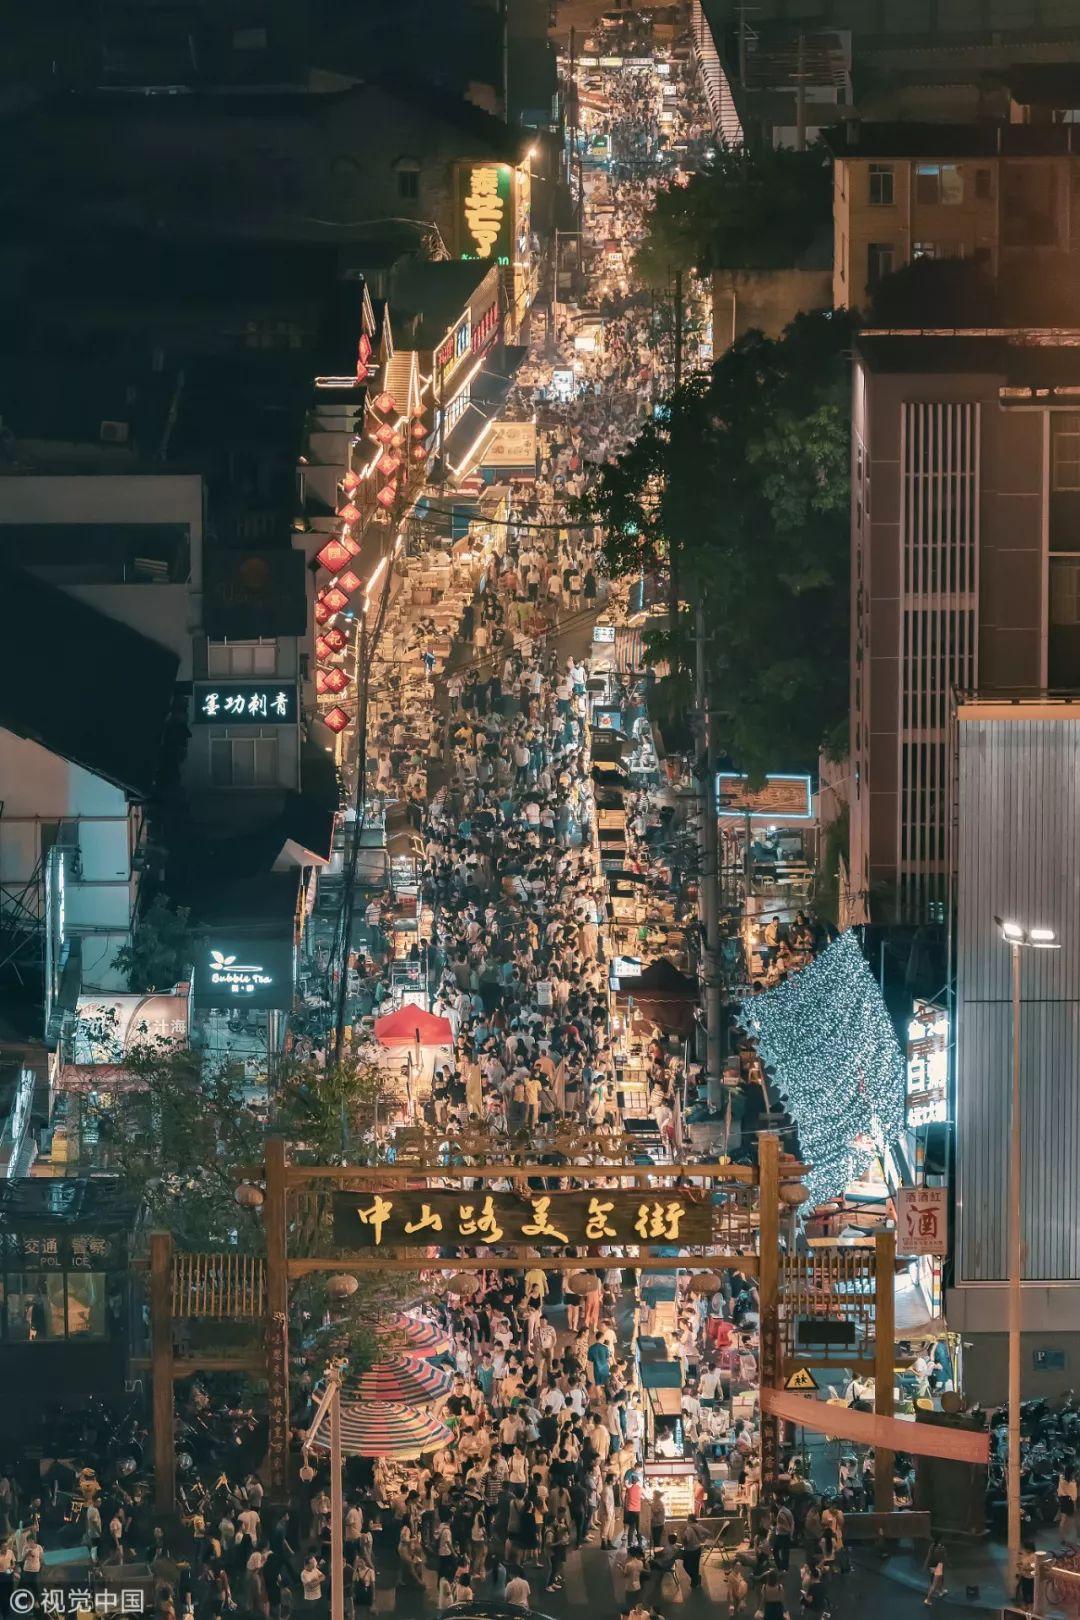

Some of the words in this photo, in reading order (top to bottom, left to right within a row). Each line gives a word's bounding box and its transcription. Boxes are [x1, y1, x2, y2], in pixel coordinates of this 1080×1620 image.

[202, 691, 289, 718] 墨功刺青
[211, 972, 251, 984] Bubble
[252, 974, 273, 984] Tea
[357, 1195, 686, 1244] 中山路美食街
[906, 1204, 941, 1239] 酒
[24, 1237, 59, 1254] 交通
[71, 1236, 106, 1254] 警察
[1037, 1351, 1046, 1361] P
